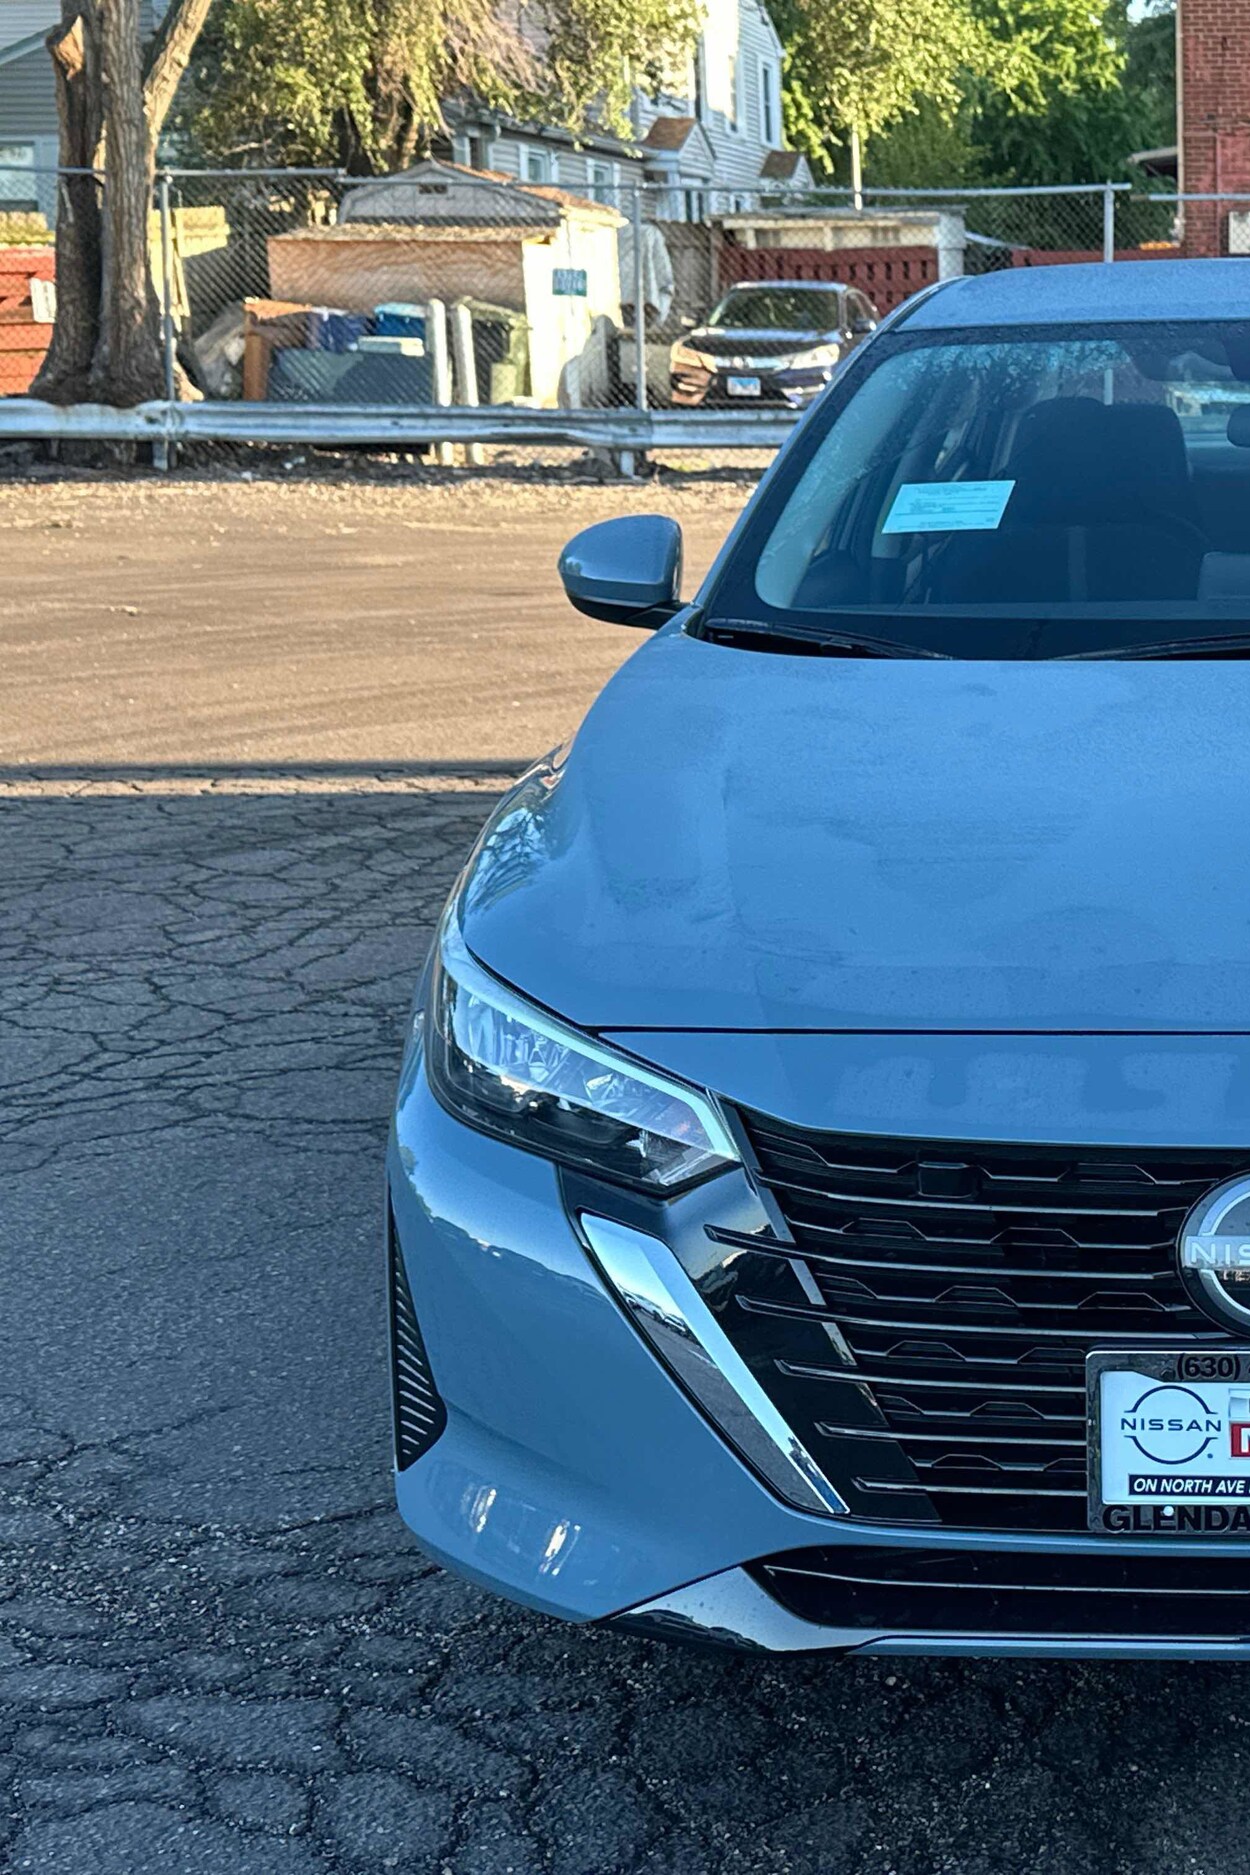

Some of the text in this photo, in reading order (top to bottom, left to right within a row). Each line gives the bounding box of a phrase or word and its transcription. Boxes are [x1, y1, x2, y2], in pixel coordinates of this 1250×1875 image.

[1177, 1353, 1241, 1380] (630)
[1121, 1418, 1221, 1432] NISSAN
[1133, 1478, 1158, 1493] ON
[1160, 1478, 1212, 1494] NORTH
[1215, 1480, 1246, 1494] AVE
